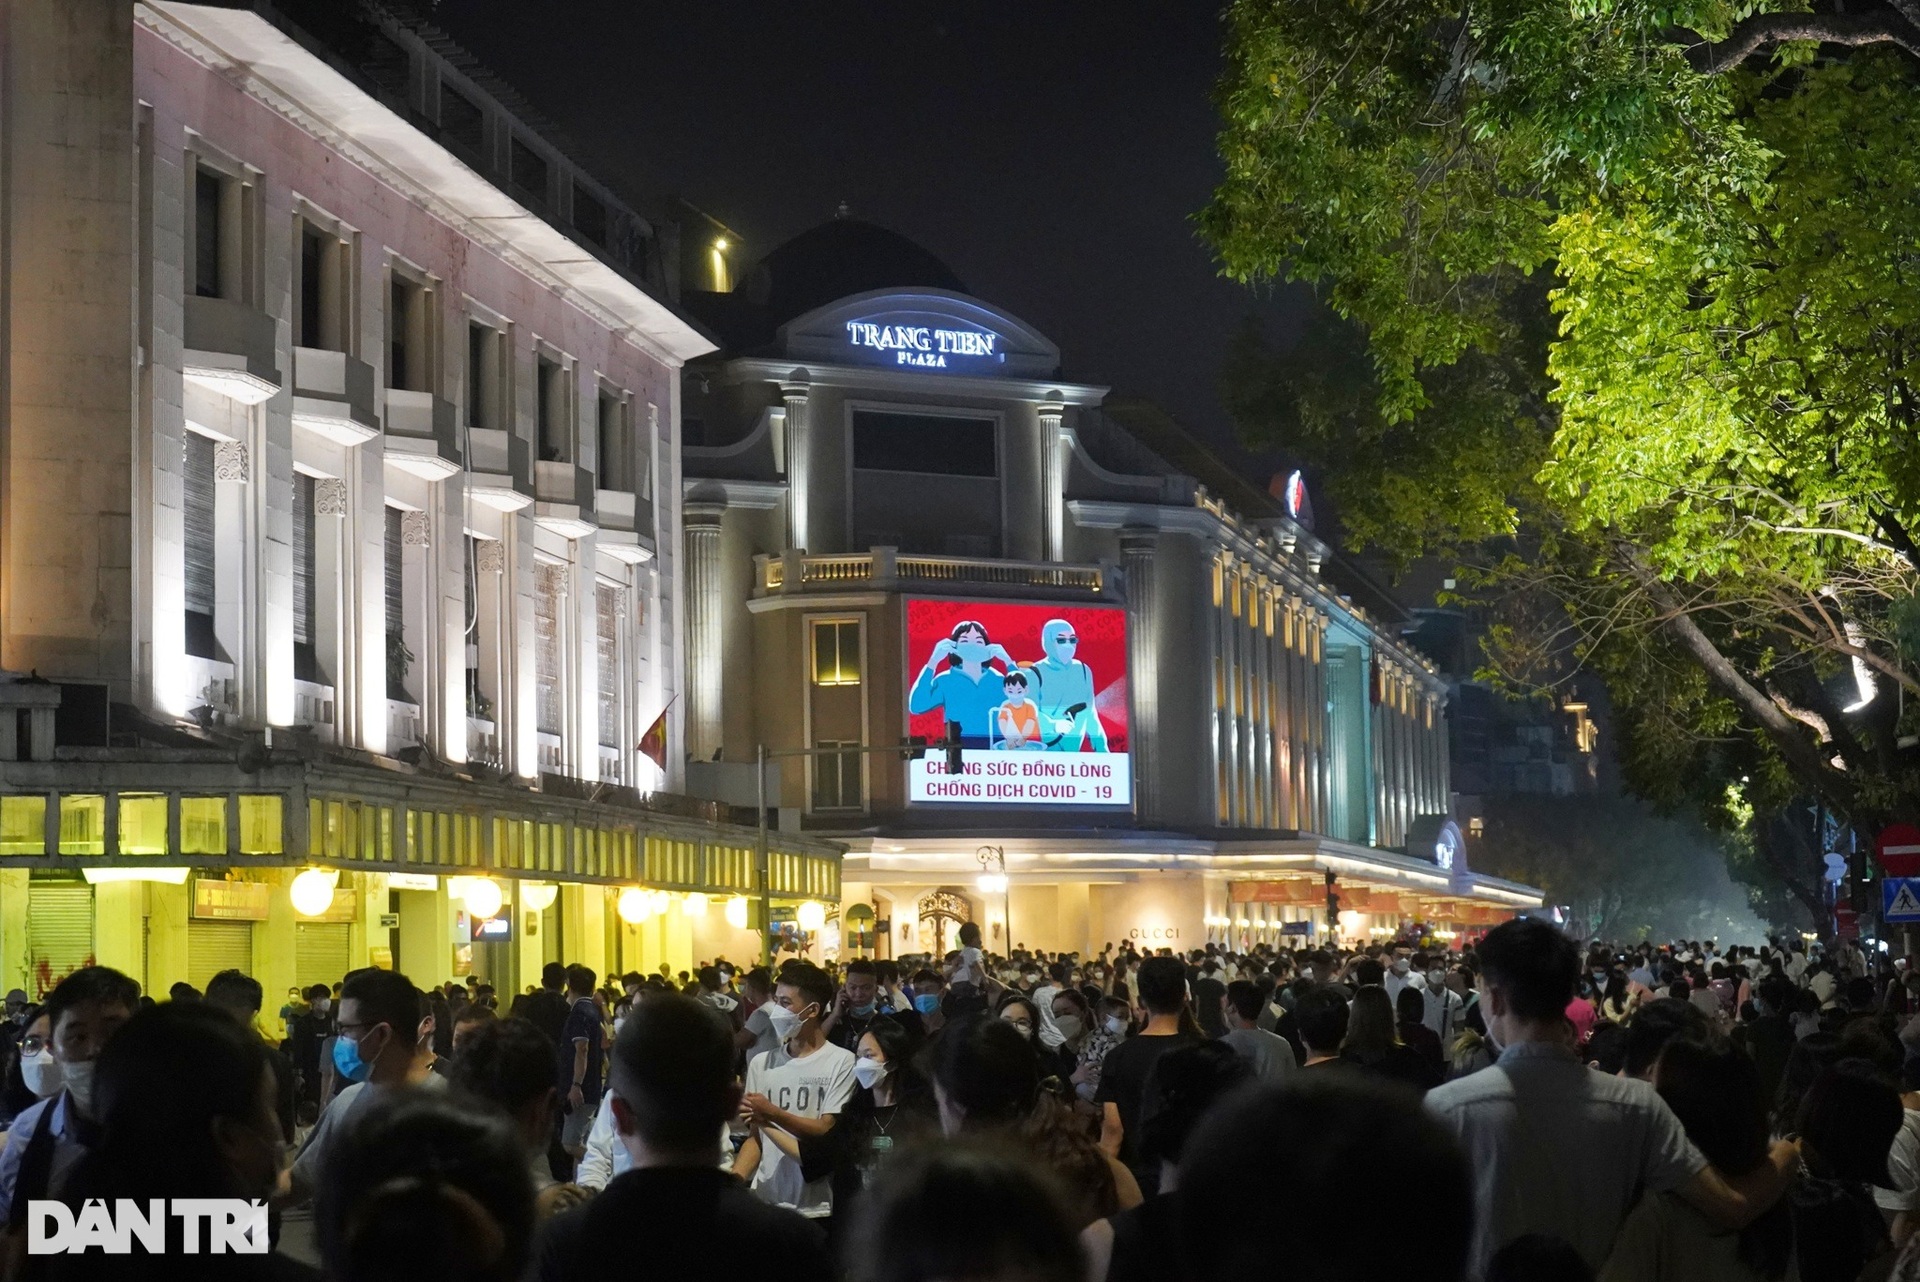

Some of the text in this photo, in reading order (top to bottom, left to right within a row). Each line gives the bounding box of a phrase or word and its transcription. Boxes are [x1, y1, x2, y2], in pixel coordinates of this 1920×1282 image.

[847, 322, 995, 356] TRANG TIEN
[897, 352, 946, 368] PLAZA
[926, 759, 1111, 778] CHNG SỨC ĐỒNG LÒNG
[926, 779, 982, 797] CHỐNG
[987, 784, 1024, 799] DỊCH
[1029, 785, 1076, 798] COVID
[1094, 785, 1112, 799] 19
[1130, 928, 1180, 939] GUCCI
